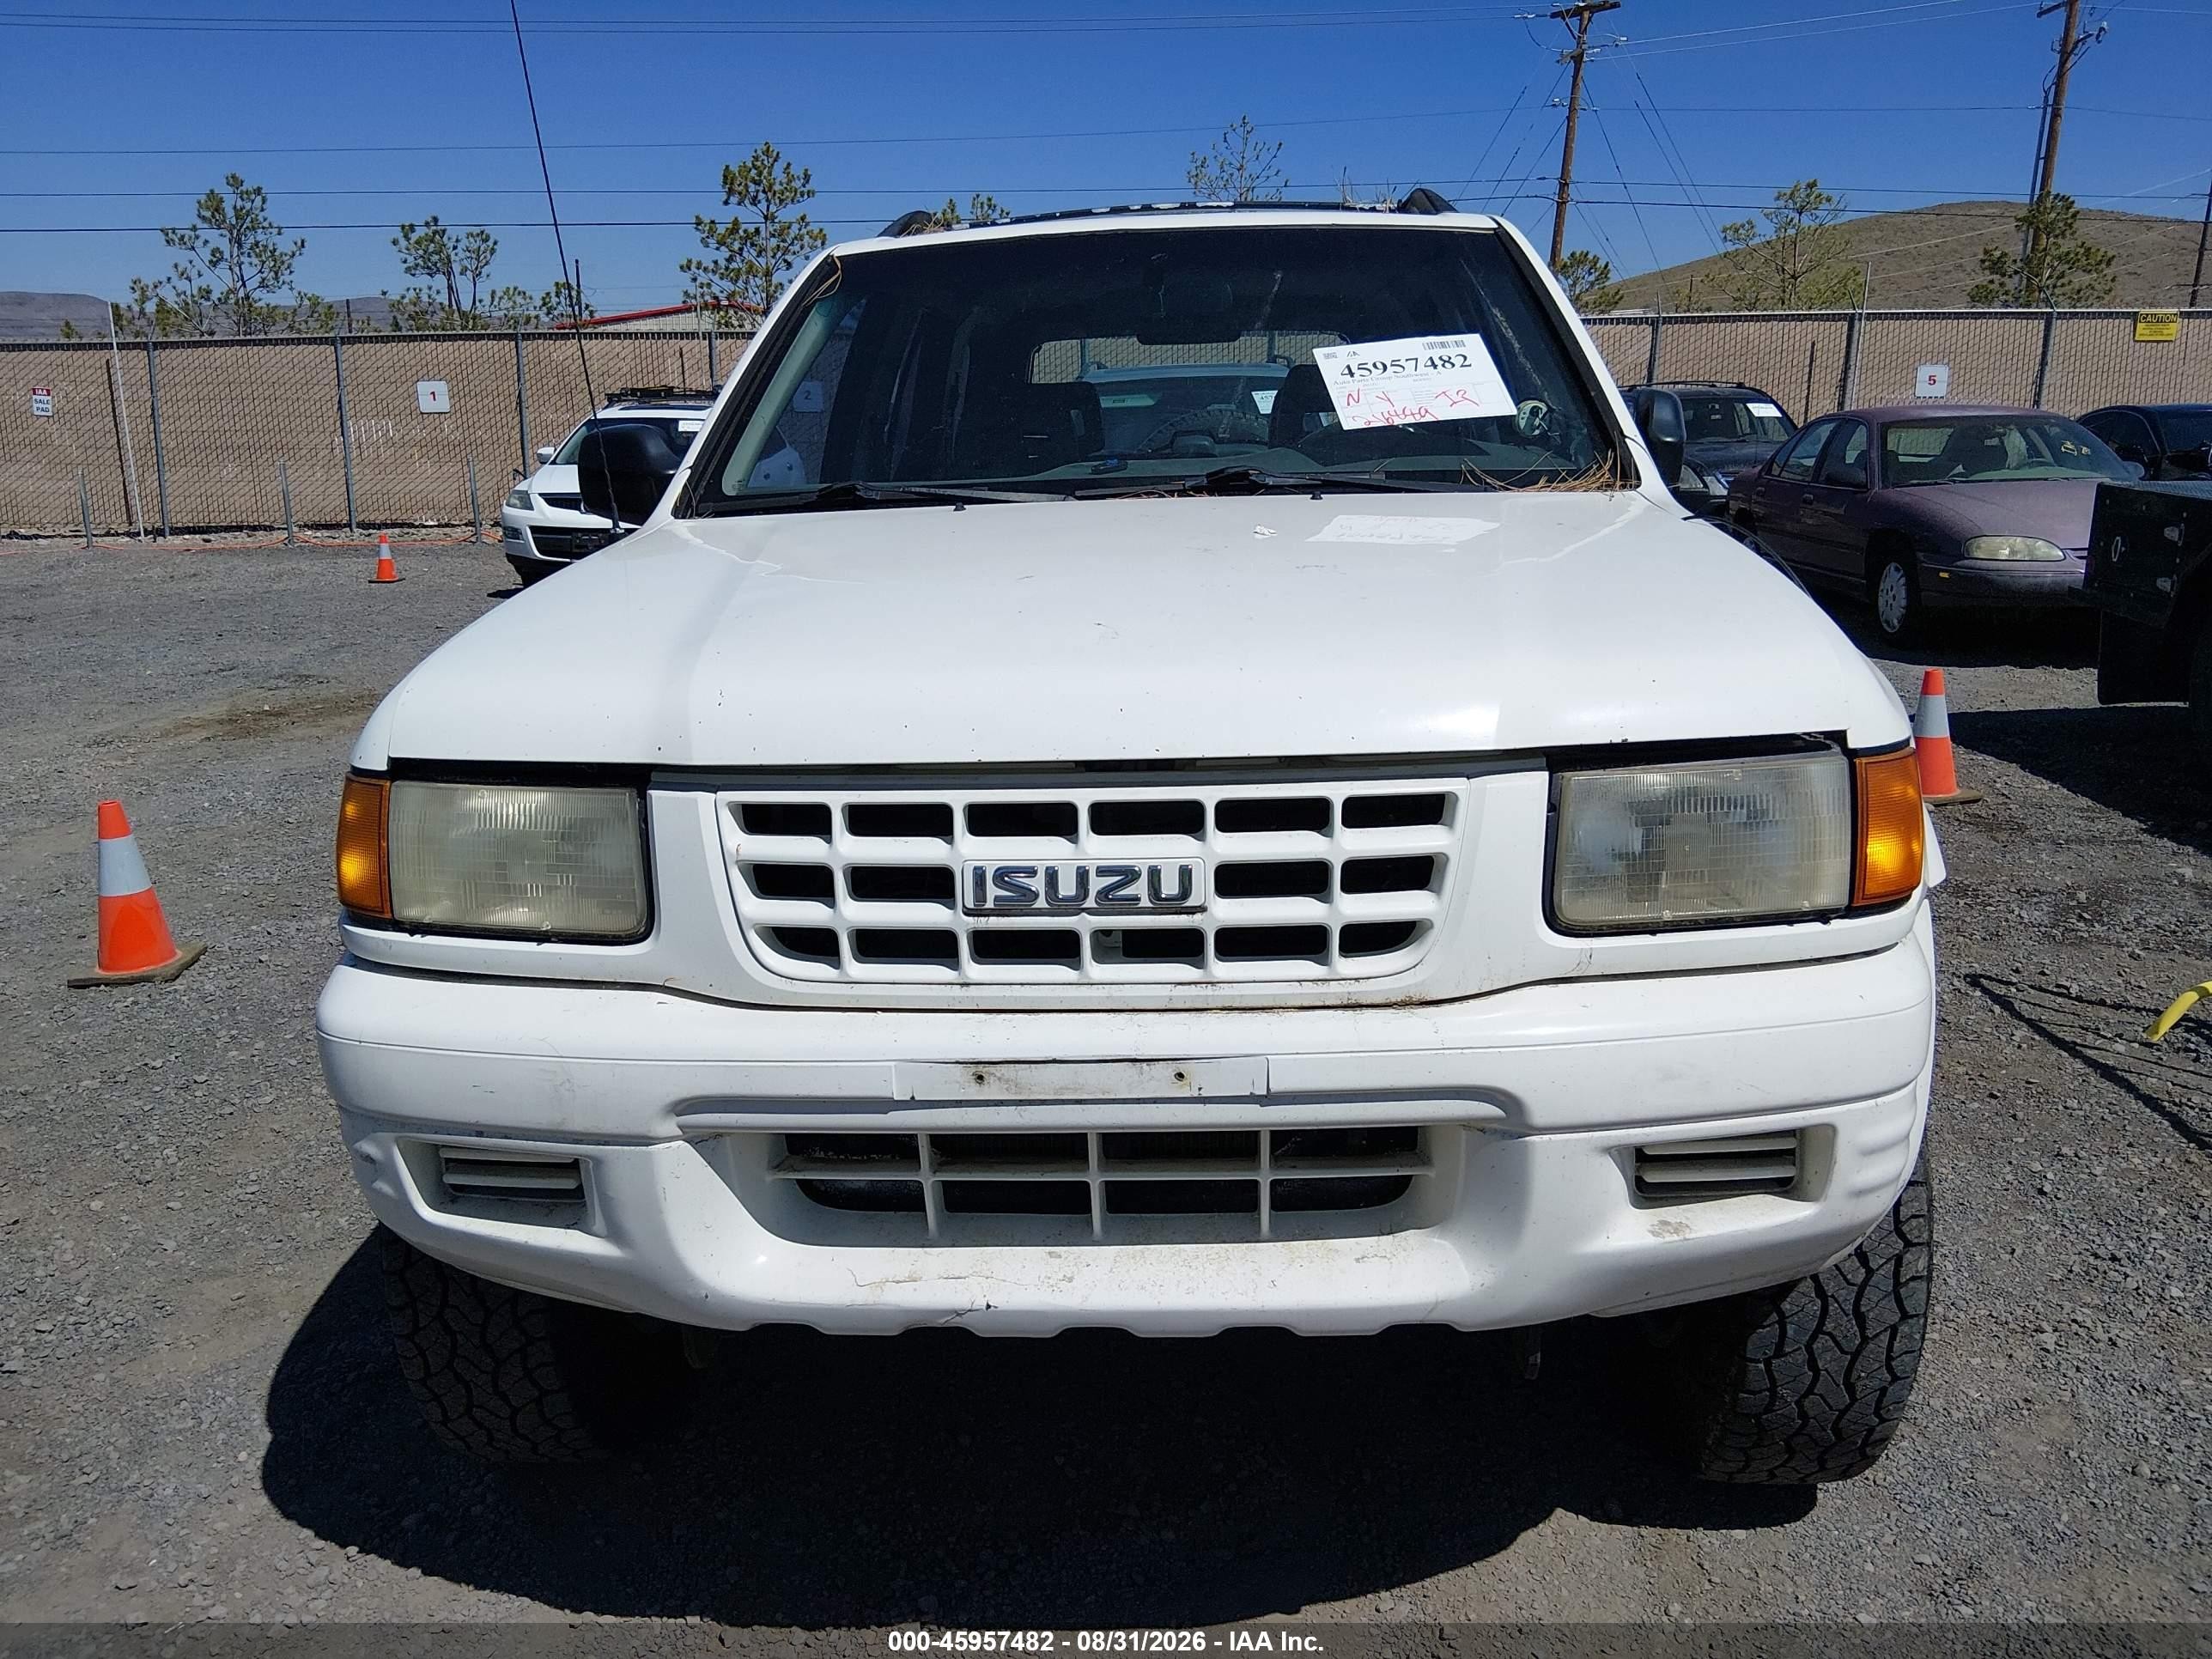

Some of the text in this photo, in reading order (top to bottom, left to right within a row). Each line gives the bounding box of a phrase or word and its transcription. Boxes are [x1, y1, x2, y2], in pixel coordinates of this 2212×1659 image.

[2140, 314, 2177, 323] CAUTION
[1340, 354, 1472, 378] 45957482
[1928, 374, 1937, 386] 5
[430, 391, 436, 402] 1
[804, 390, 811, 400] 2
[1346, 388, 1360, 407] N
[972, 864, 1194, 907] ISUZU
